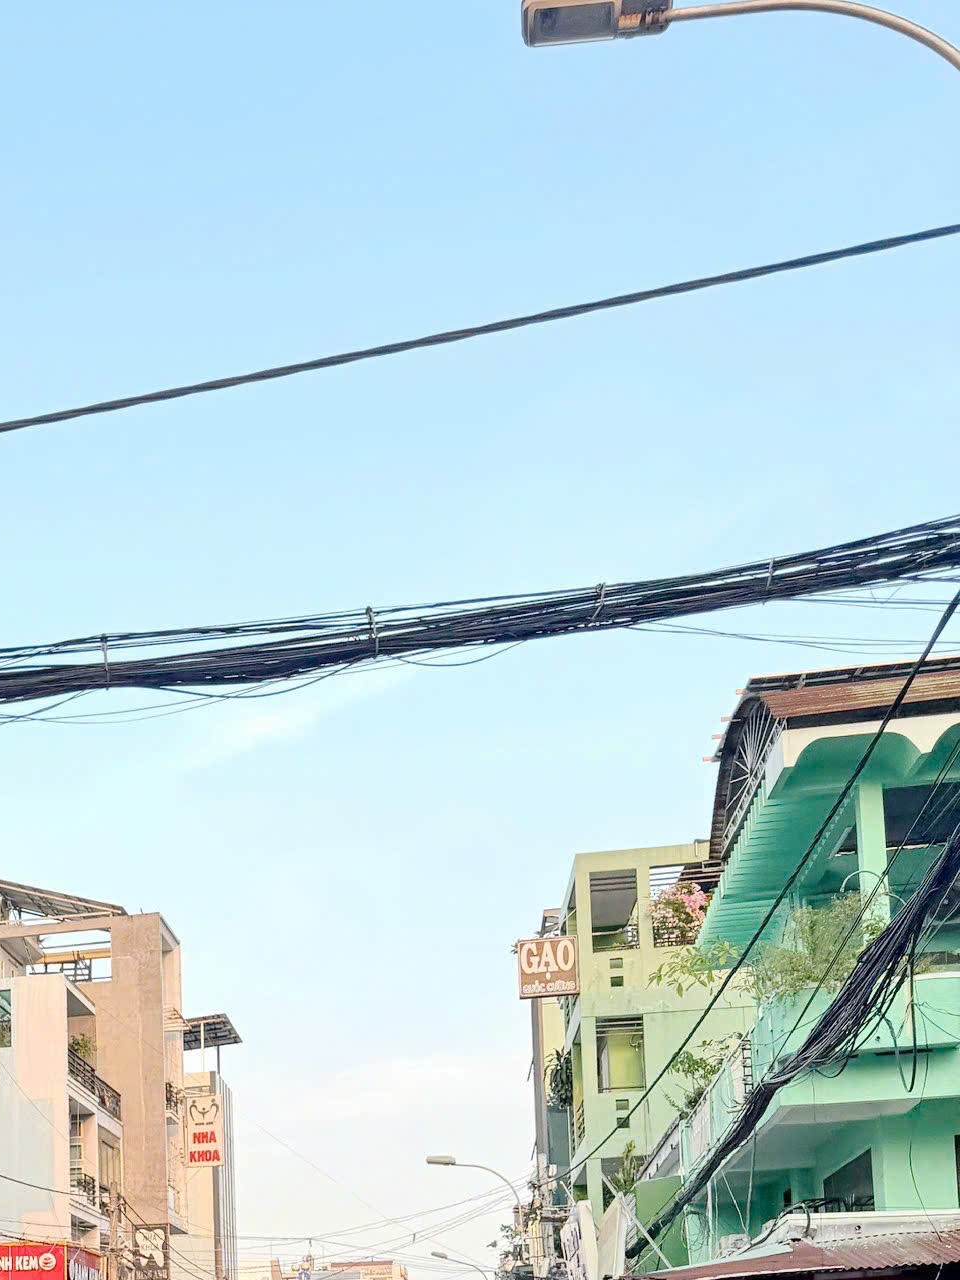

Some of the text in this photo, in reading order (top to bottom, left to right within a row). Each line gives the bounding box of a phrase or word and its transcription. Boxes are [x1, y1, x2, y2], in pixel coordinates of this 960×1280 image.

[521, 940, 575, 980] GẠO
[193, 1131, 217, 1144] NHA
[189, 1150, 220, 1163] KHOA
[15, 1256, 39, 1271] KEM
